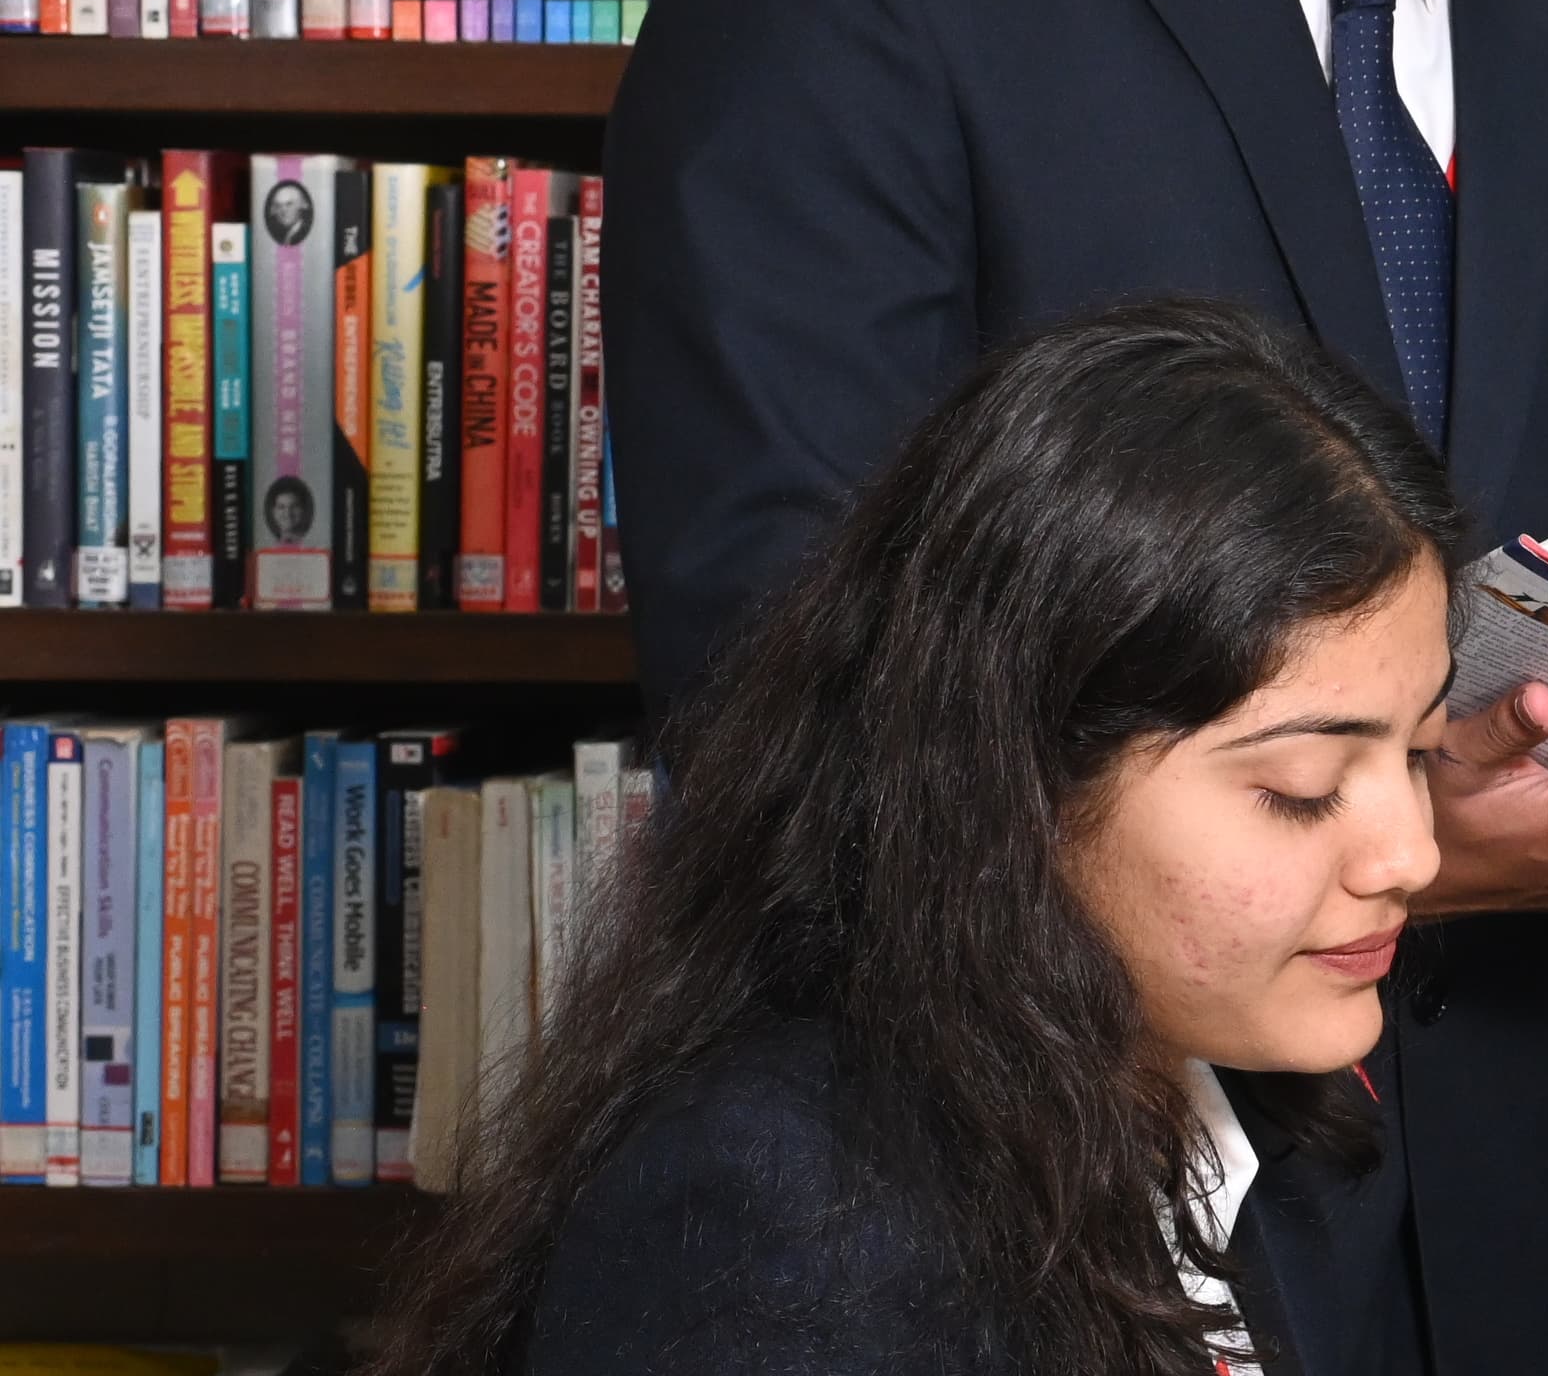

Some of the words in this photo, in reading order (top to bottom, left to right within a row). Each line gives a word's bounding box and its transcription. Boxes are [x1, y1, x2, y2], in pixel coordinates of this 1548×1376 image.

[581, 216, 599, 264] RAM
[34, 249, 60, 367] MISSION
[90, 241, 113, 338] JAMSETJI
[465, 281, 497, 348] MADE
[516, 221, 540, 354] CREATOR'S
[581, 275, 599, 366] CHARAN
[93, 348, 112, 398] TATA
[515, 363, 537, 434] CODE
[465, 375, 497, 448] CHINA
[342, 786, 366, 841] Work
[342, 847, 366, 897] Goes
[228, 860, 260, 1021] COMMUNICATING
[342, 904, 366, 971] Mobile
